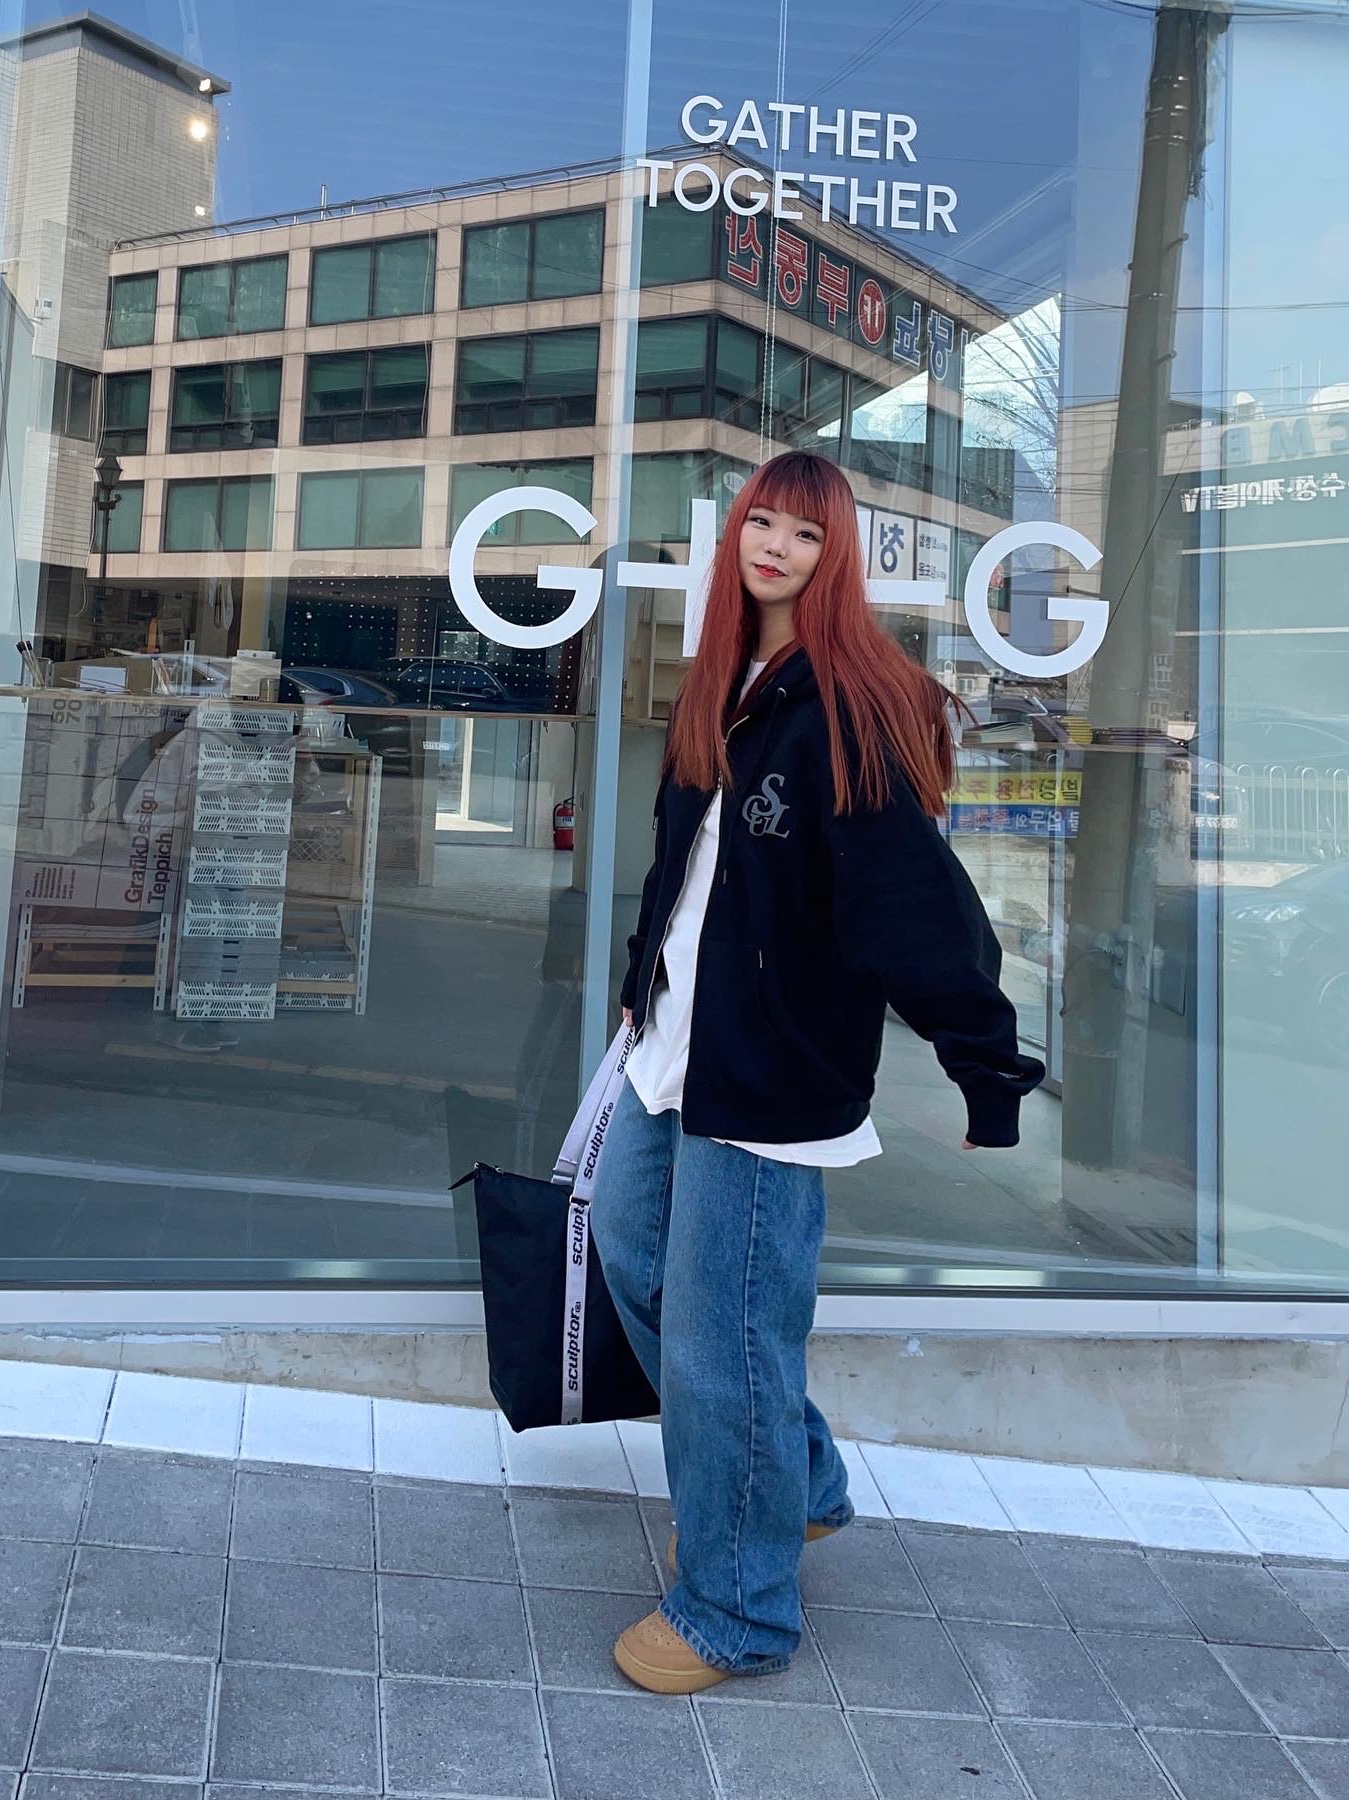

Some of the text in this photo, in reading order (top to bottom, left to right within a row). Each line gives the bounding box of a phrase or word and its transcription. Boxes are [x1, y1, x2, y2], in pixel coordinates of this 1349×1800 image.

[681, 95, 918, 163] GATHER
[636, 158, 958, 234] TOGETHER
[148, 832, 173, 904] Teppich
